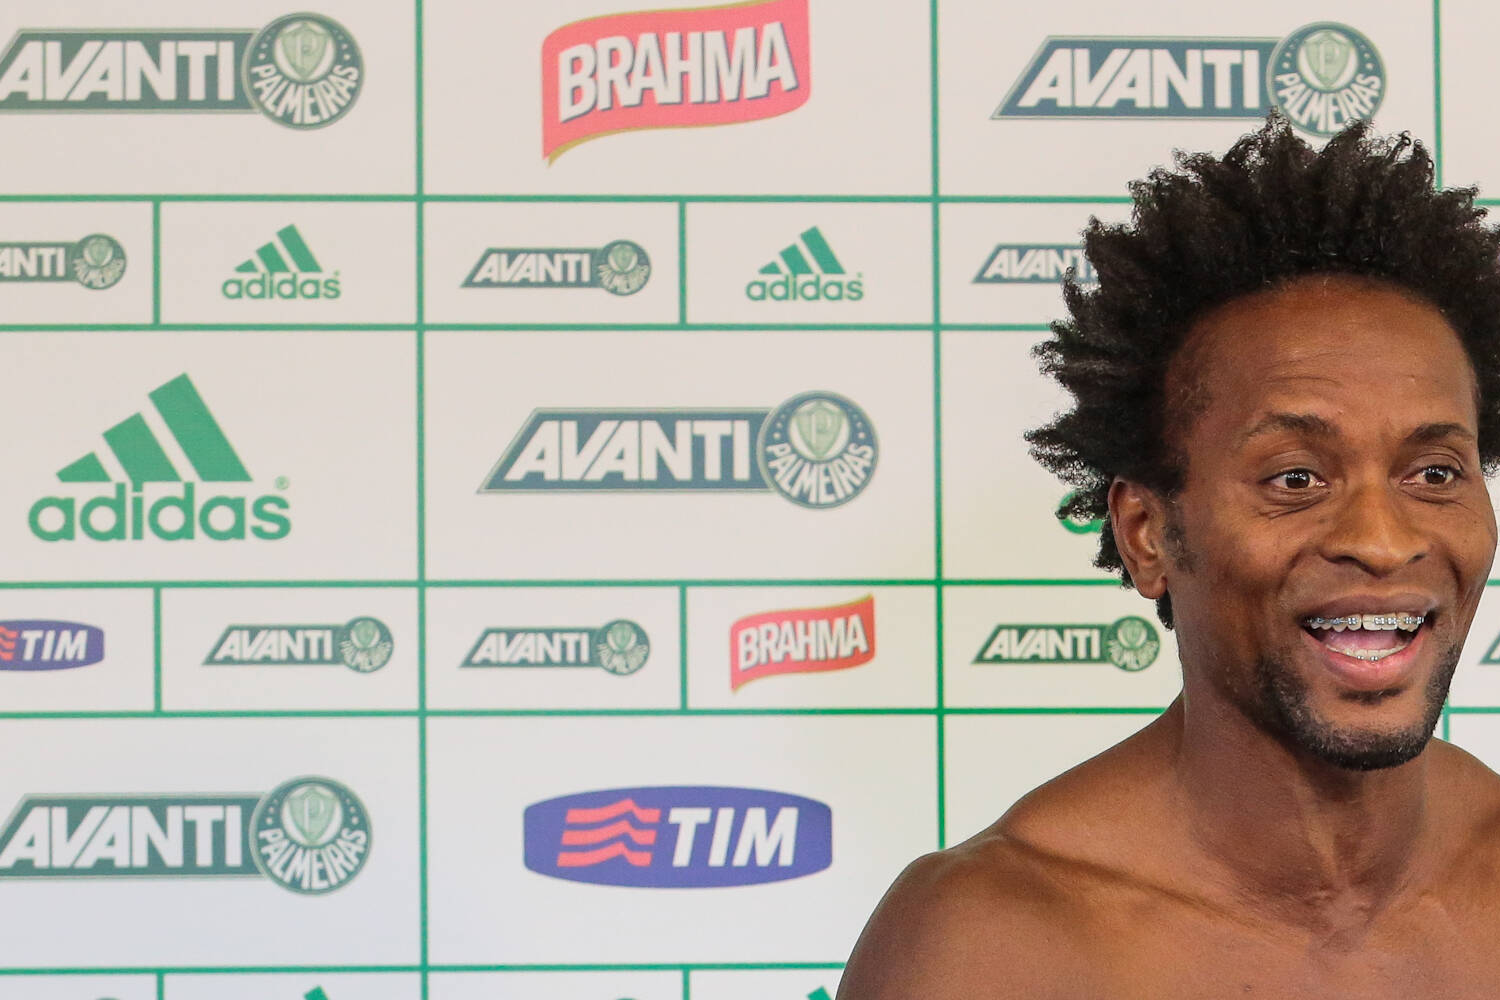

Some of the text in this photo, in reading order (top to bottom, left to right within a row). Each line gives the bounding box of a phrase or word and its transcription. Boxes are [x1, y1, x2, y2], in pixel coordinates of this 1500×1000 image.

[0, 40, 234, 100] AVANTI
[251, 61, 360, 124] PALMEIRAS
[558, 22, 799, 123] BRAHMA
[1019, 49, 1257, 108] AVANTI
[1275, 72, 1381, 134] PALMEIRAS
[222, 268, 341, 299] adidas
[473, 253, 590, 283] AVANTI
[747, 270, 863, 301] adidas
[503, 420, 750, 480] AVANTI
[765, 437, 873, 507] PALMEIRAS
[27, 480, 292, 542] adidas
[20, 630, 88, 660] TIM
[212, 630, 333, 660] AVANTI
[470, 632, 590, 663] AVANTI
[737, 613, 868, 670] BRAHMA
[984, 629, 1099, 659] AVANTI
[0, 806, 242, 868] AVANTI
[257, 826, 368, 890] PALMEIRAS
[669, 808, 797, 867] TIM
